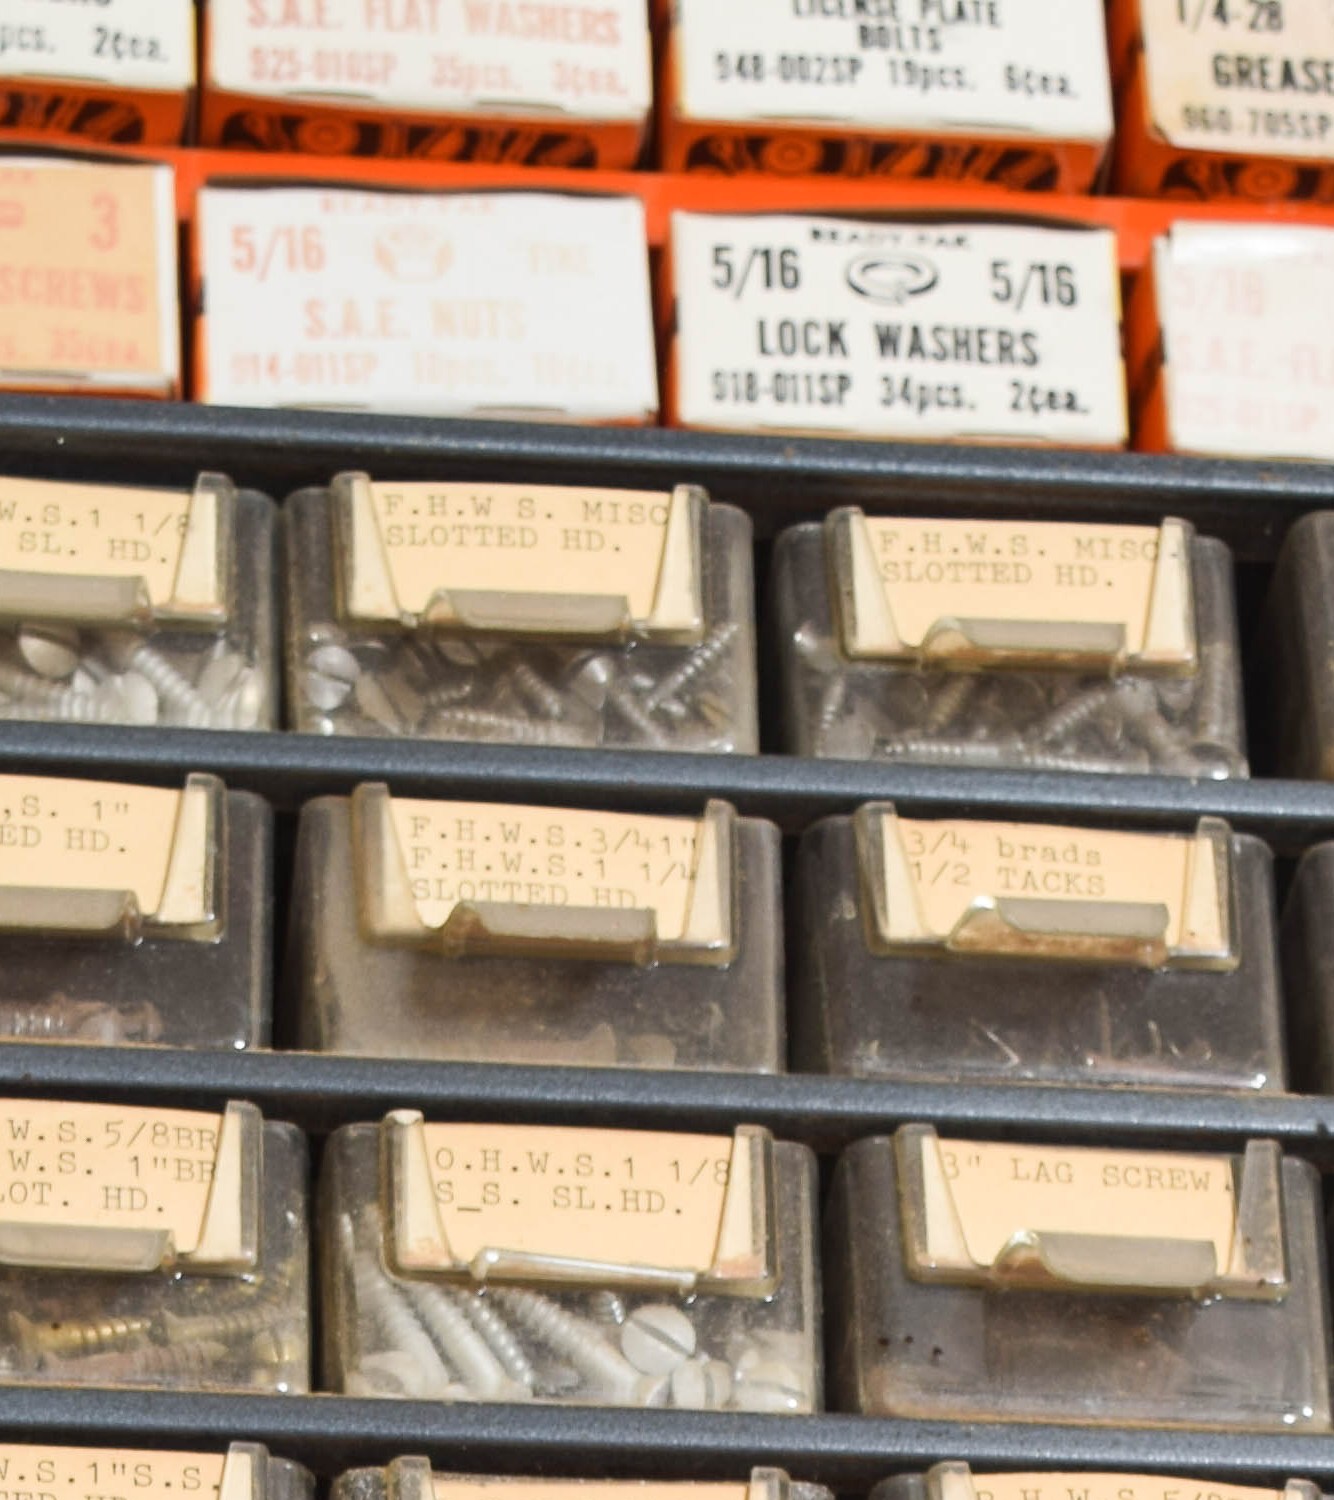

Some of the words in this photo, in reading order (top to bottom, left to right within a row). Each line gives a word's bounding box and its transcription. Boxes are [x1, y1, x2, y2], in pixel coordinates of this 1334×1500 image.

[857, 22, 944, 54] BOLTS
[89, 192, 120, 252] 3
[231, 225, 327, 281] 5/16
[711, 244, 803, 301] 5/16
[990, 260, 1080, 312] 5/16
[304, 298, 411, 341] S.A.E.
[757, 316, 851, 359] LOCK
[872, 321, 1042, 368] WASHERS
[879, 374, 979, 417] 34pcs.
[1008, 379, 1093, 417] 2¢ea.
[108, 538, 167, 563] HD.
[386, 525, 538, 549] SLOTTED
[561, 528, 621, 553] HD.
[880, 561, 1033, 585] SLOTTED
[1056, 564, 1114, 587] HD.
[66, 827, 127, 853] HD.
[996, 835, 1102, 867] brads
[996, 868, 1106, 896] TACKS
[1012, 1158, 1074, 1185] LAG
[102, 1185, 165, 1213] HD.
